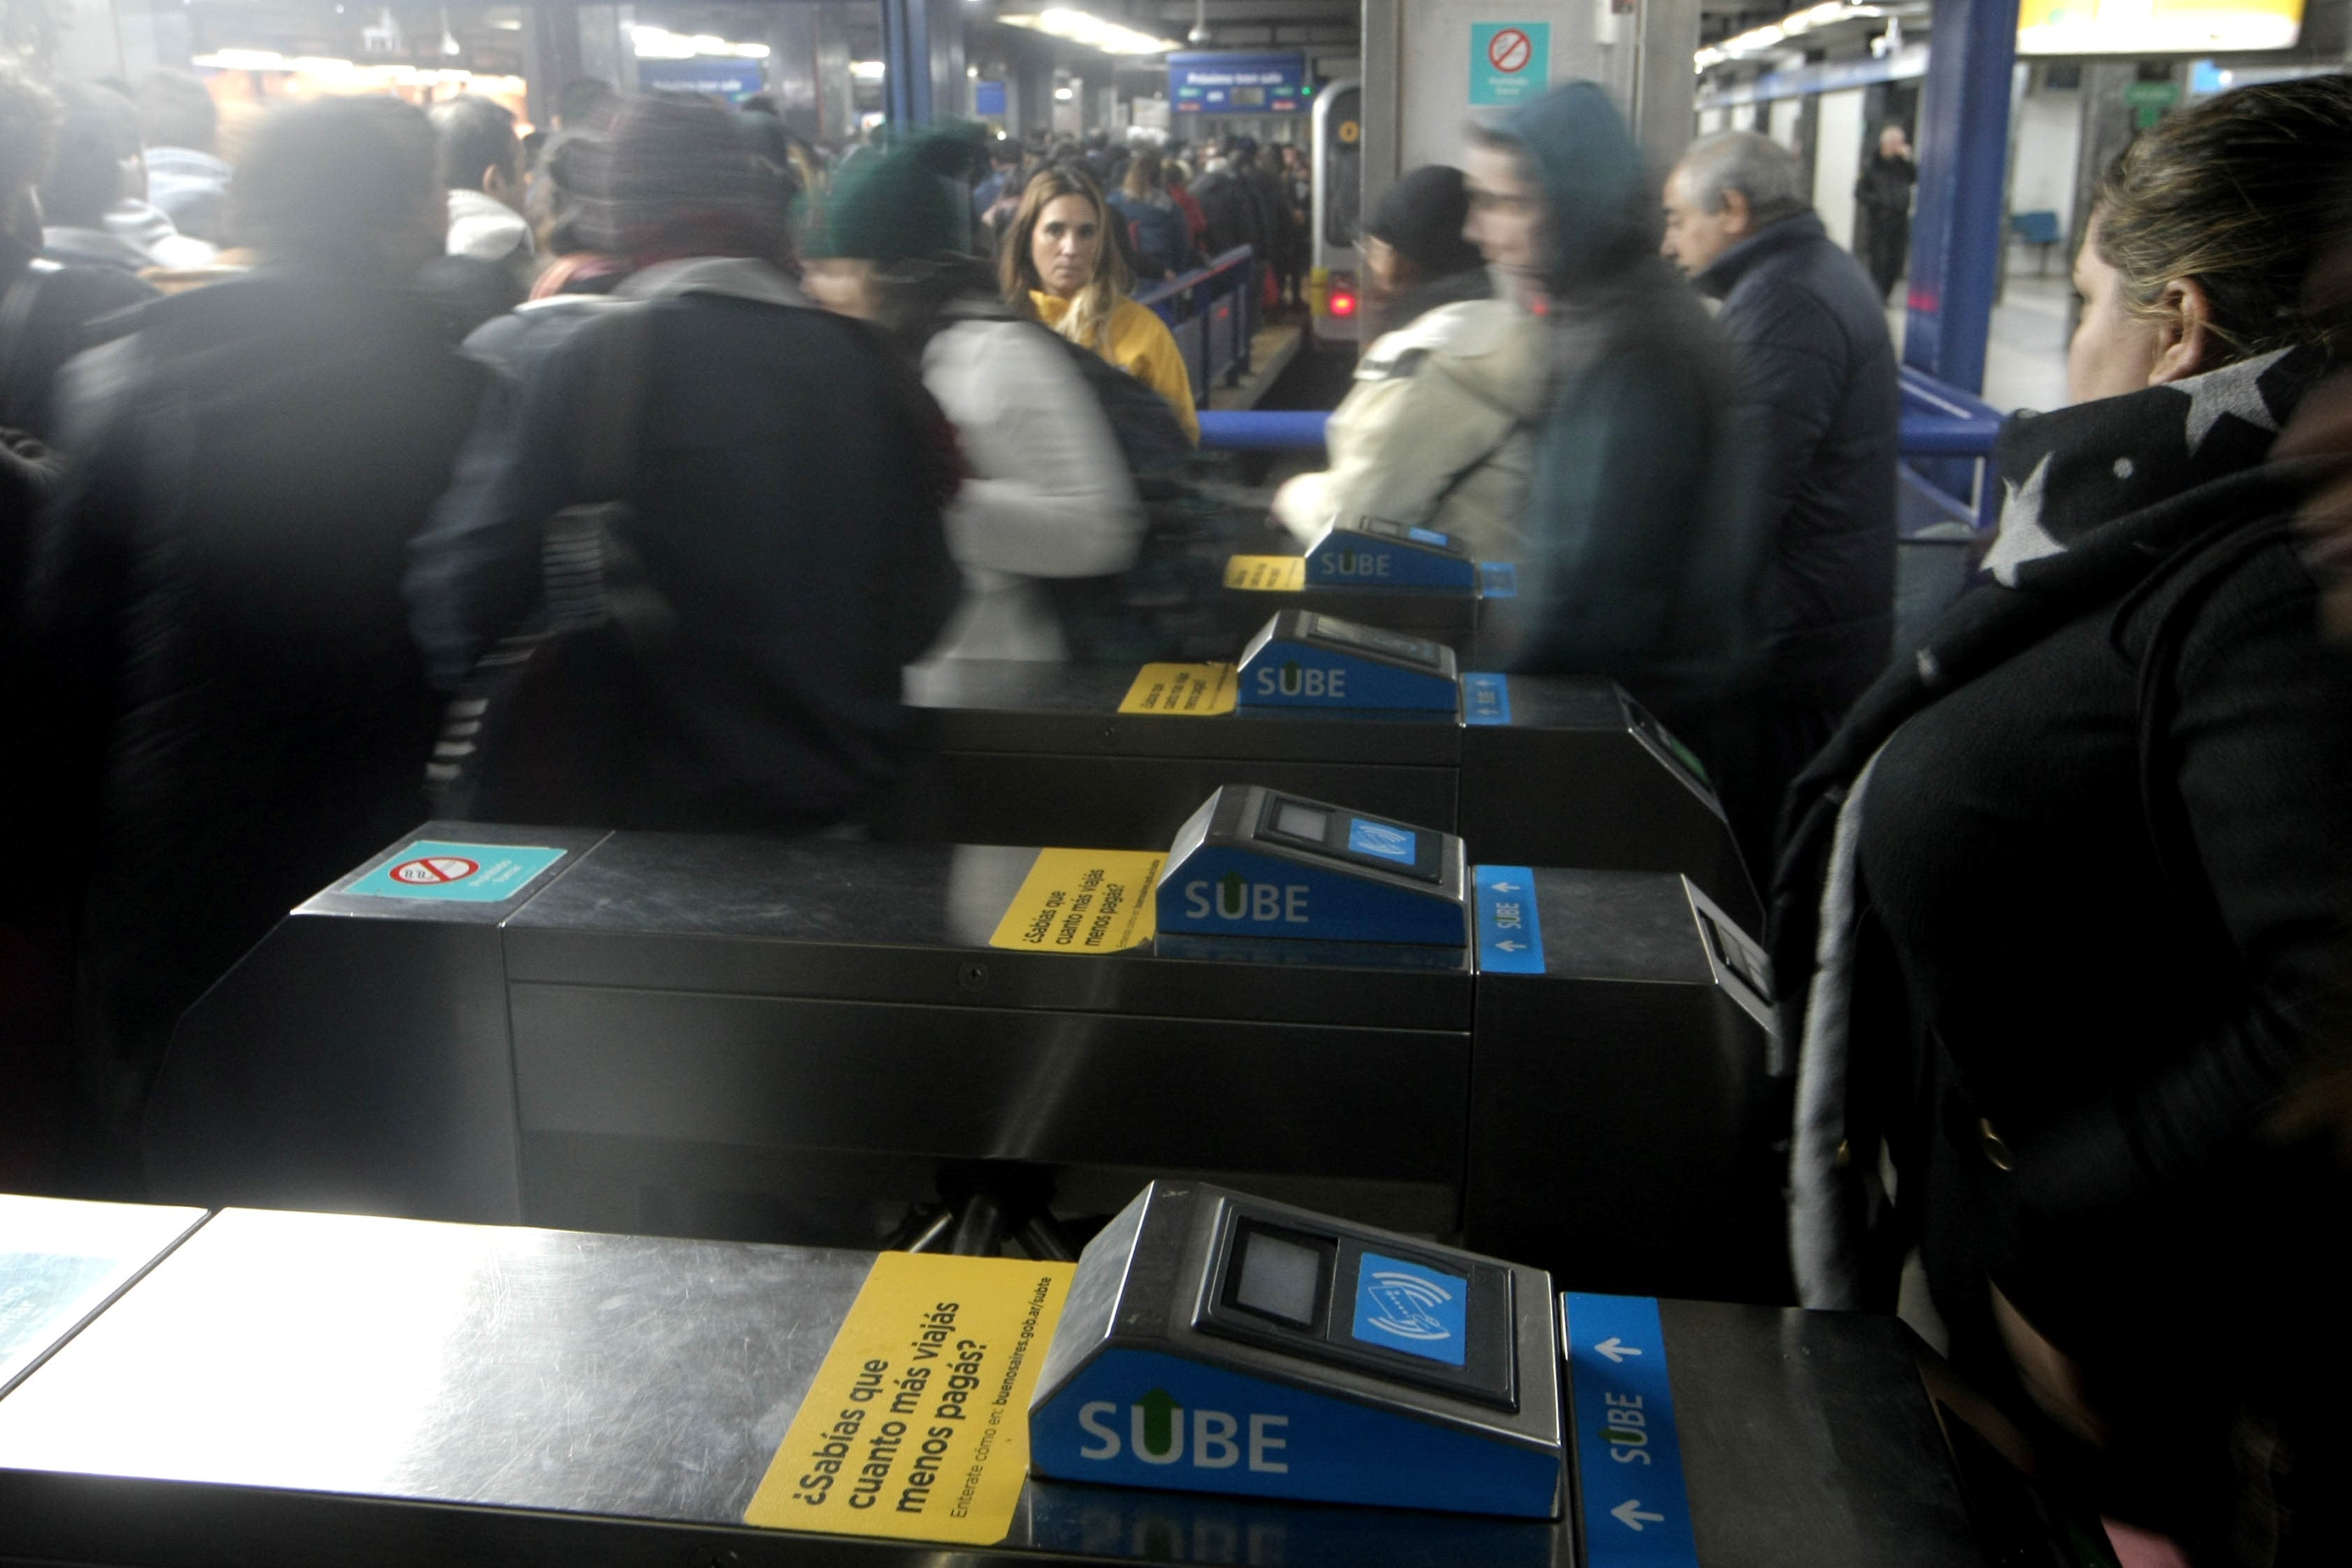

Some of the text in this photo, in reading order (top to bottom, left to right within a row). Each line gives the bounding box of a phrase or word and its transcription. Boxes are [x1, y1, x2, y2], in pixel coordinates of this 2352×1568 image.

[1321, 554, 1392, 577] SUBE
[1258, 667, 1346, 698] SUBE
[1022, 890, 1066, 943] ¿Sabías que
[1056, 869, 1104, 945] cuanto más viajás
[1084, 883, 1125, 947] menos pagás?
[1185, 879, 1309, 923] SUBE
[1495, 901, 1521, 931] SUBE
[792, 1359, 889, 1507] ¿Sabías que
[848, 1301, 959, 1510] cuanto más viajás
[896, 1339, 987, 1513] menos pagás?
[950, 1277, 1052, 1518] Enterate cómo en: buenosaires.gob.ar/subte
[1605, 1392, 1651, 1465] SUBE
[1077, 1398, 1289, 1474] SUBE
